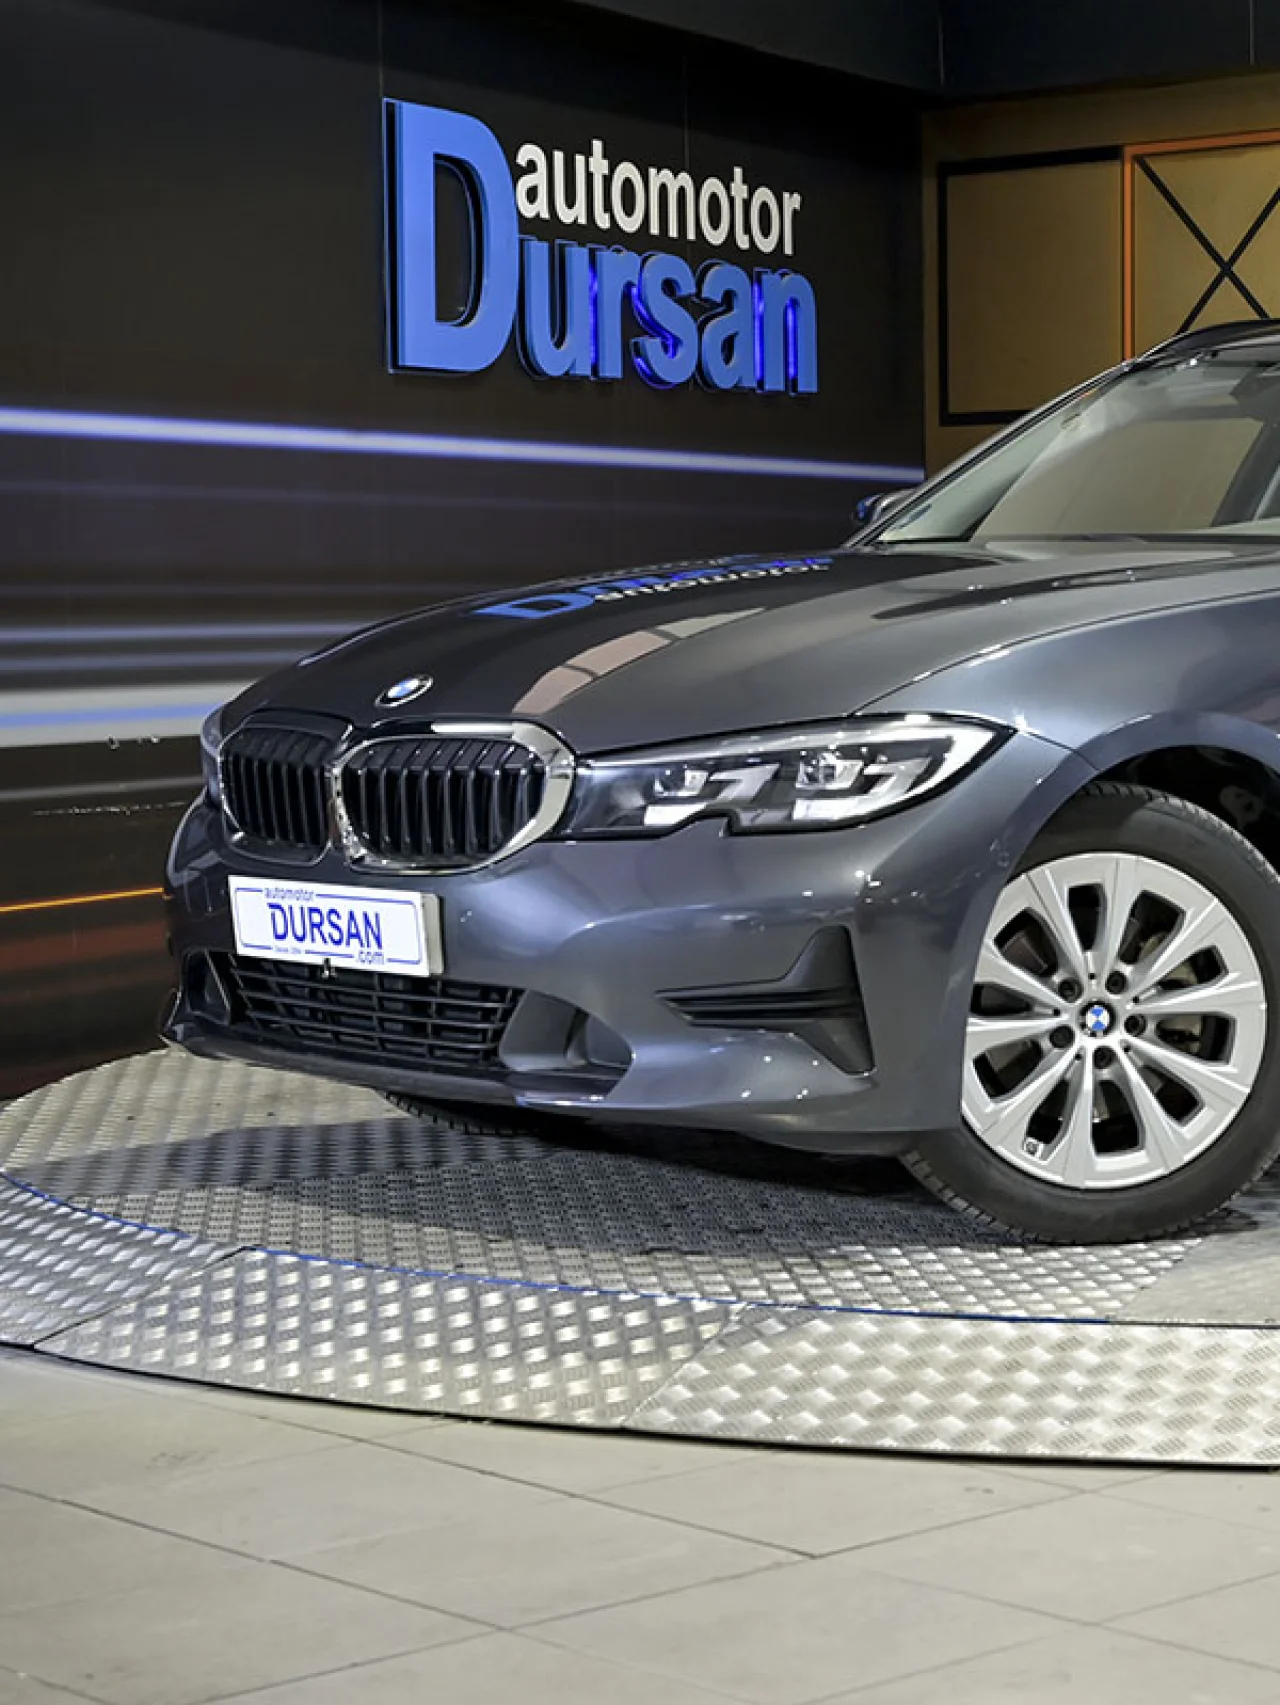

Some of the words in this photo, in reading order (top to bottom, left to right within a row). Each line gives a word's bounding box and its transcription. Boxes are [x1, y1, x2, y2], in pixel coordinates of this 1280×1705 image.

[515, 138, 802, 256] automotor
[384, 97, 818, 395] Dursan
[264, 887, 315, 902] automotor
[267, 902, 383, 949] DURSAN
